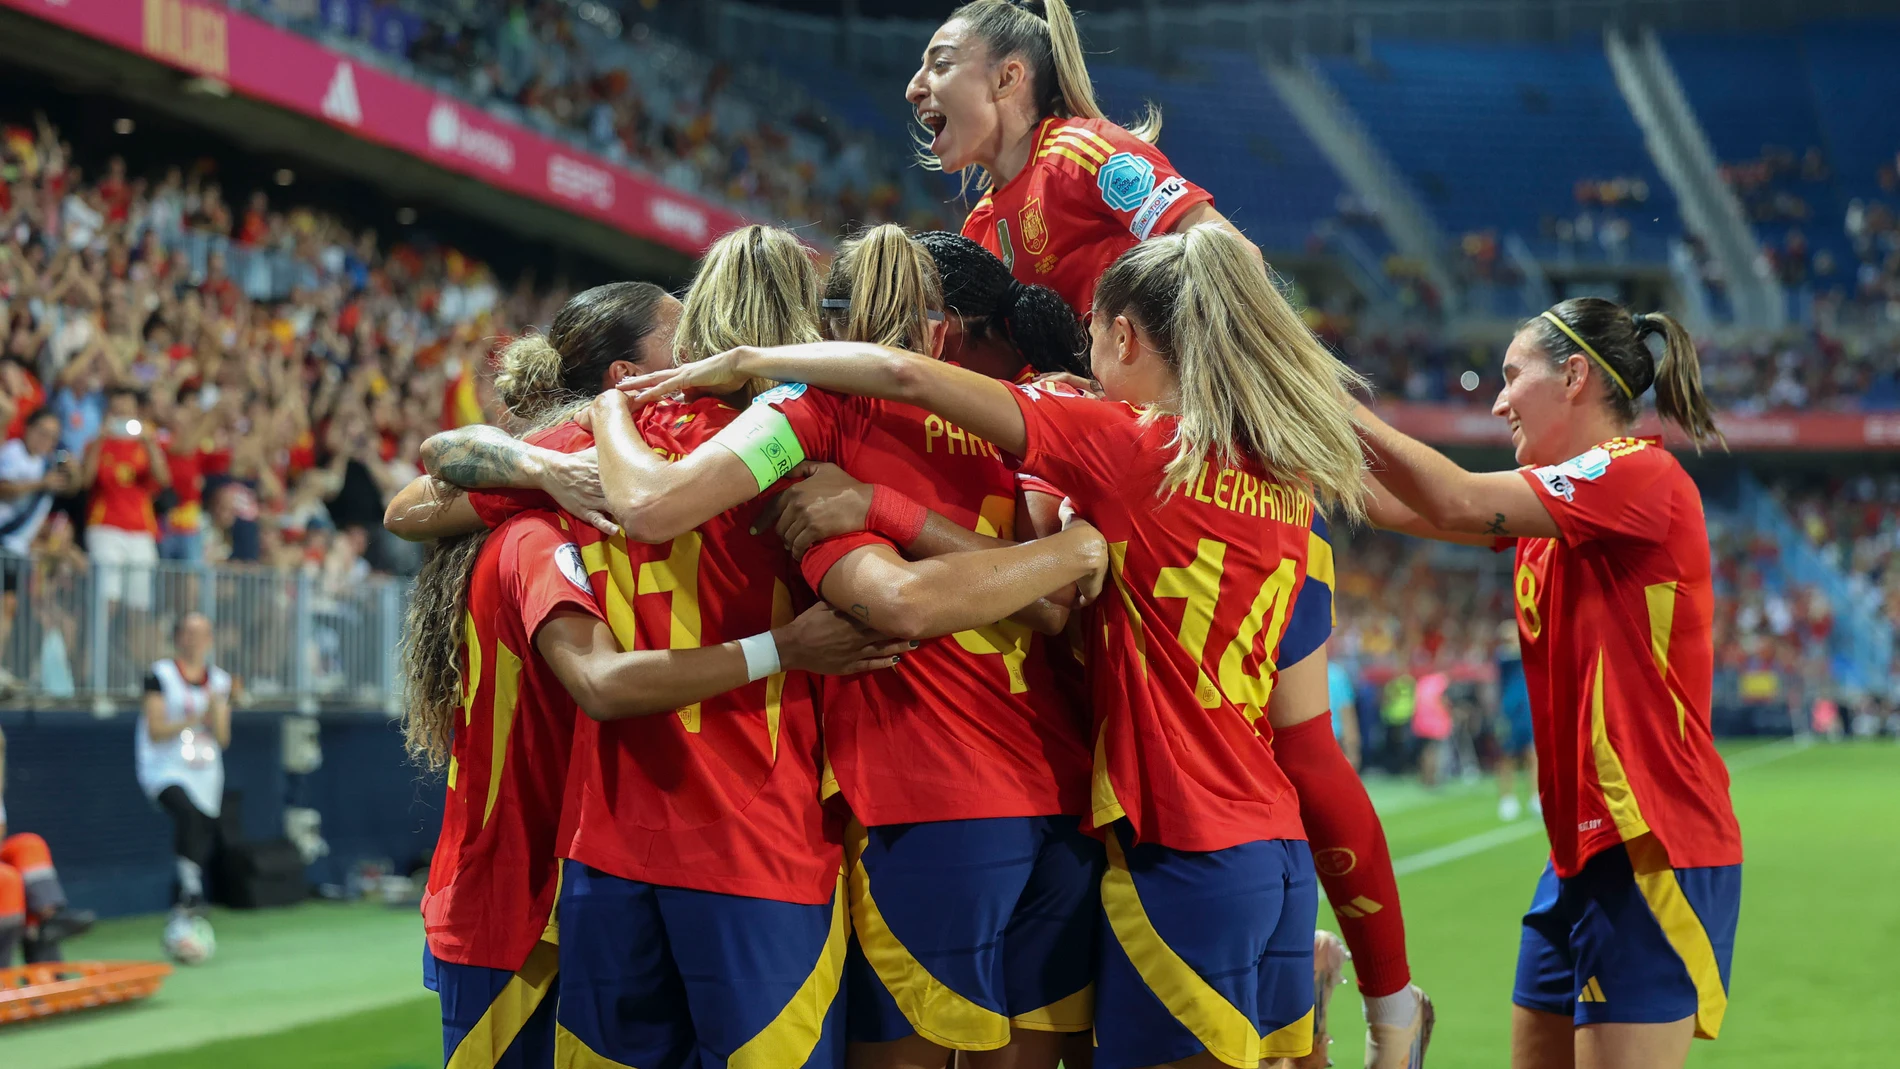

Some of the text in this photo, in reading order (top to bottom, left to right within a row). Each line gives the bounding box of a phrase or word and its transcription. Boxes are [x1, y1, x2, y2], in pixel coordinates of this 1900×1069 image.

[1135, 194, 1165, 237] FOUNDATION
[1153, 538, 1297, 737] 14
[1515, 563, 1542, 639] 8
